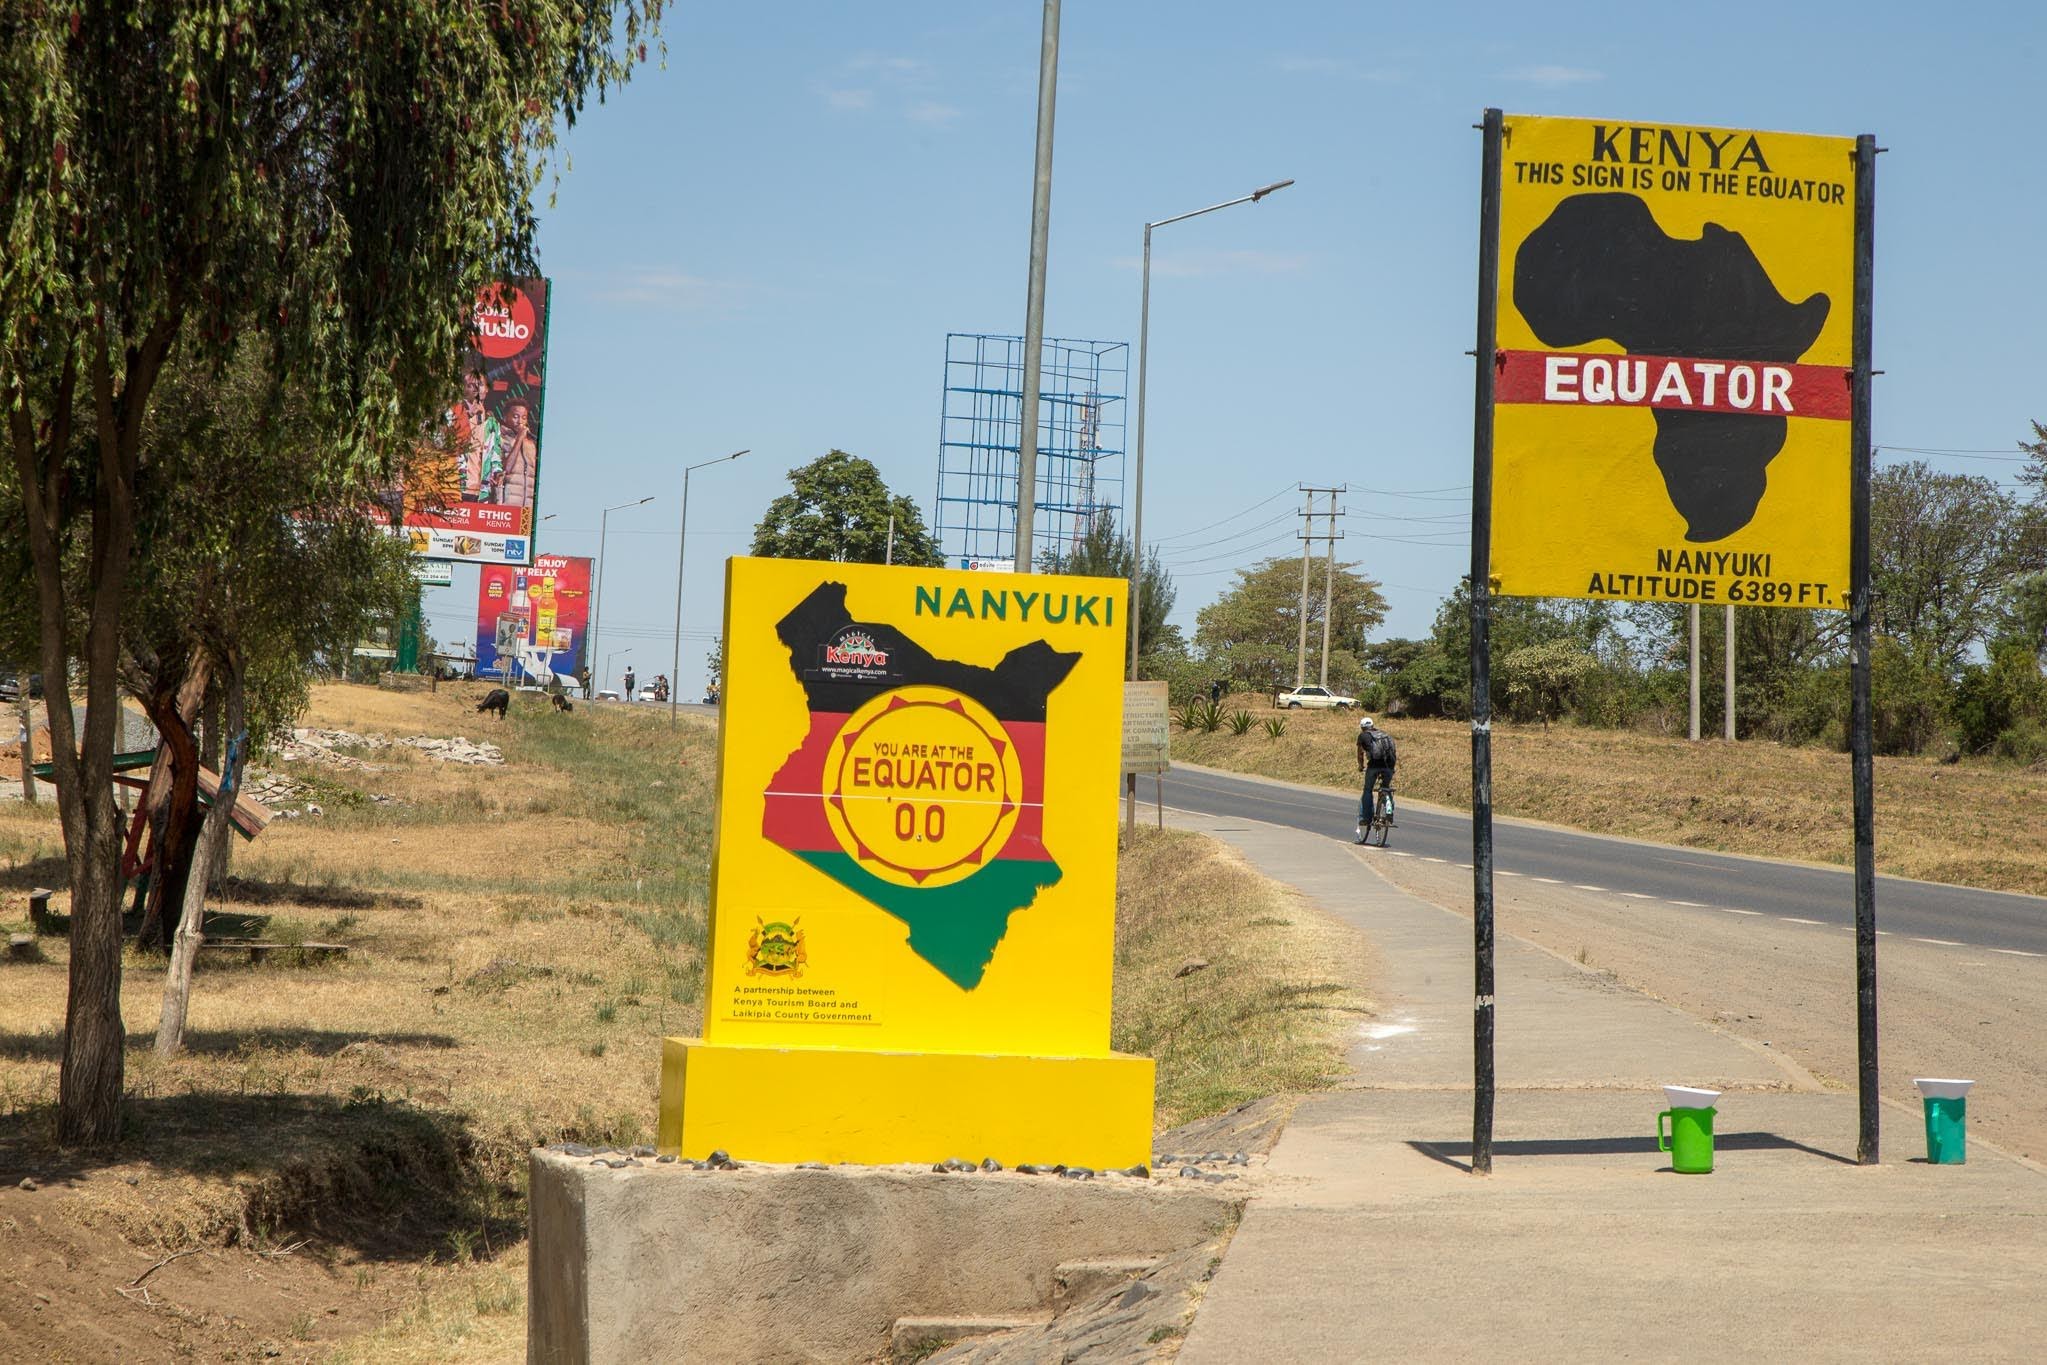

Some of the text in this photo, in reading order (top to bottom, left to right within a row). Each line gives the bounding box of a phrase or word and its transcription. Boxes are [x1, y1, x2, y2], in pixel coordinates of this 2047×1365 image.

[1592, 125, 1773, 173] KENYA
[1515, 162, 1845, 205] THIS SIGN IS ON THE EQUATOR
[473, 317, 529, 339] tudio
[1544, 356, 1794, 412] EQUATOR
[478, 510, 512, 521] ETHIC
[486, 521, 511, 529] KENYA
[528, 568, 558, 577] RELAX
[538, 559, 567, 568] ENJOY
[1657, 549, 1771, 577] NANYUKI
[1588, 572, 1832, 605] ALTITUDE 6389 FT.
[915, 585, 1113, 627] NANYUKI
[827, 646, 887, 667] Kenya
[822, 666, 887, 676] www.magicalkenya.com
[874, 742, 974, 760] YOU ARE AT THE
[854, 757, 995, 792] EQUATOR
[895, 803, 945, 843] 0.0
[743, 986, 794, 996] partnership
[797, 988, 835, 996] between
[733, 998, 858, 1009] Kenya Tourism Board and
[733, 1010, 872, 1021] Laikipia County Government
